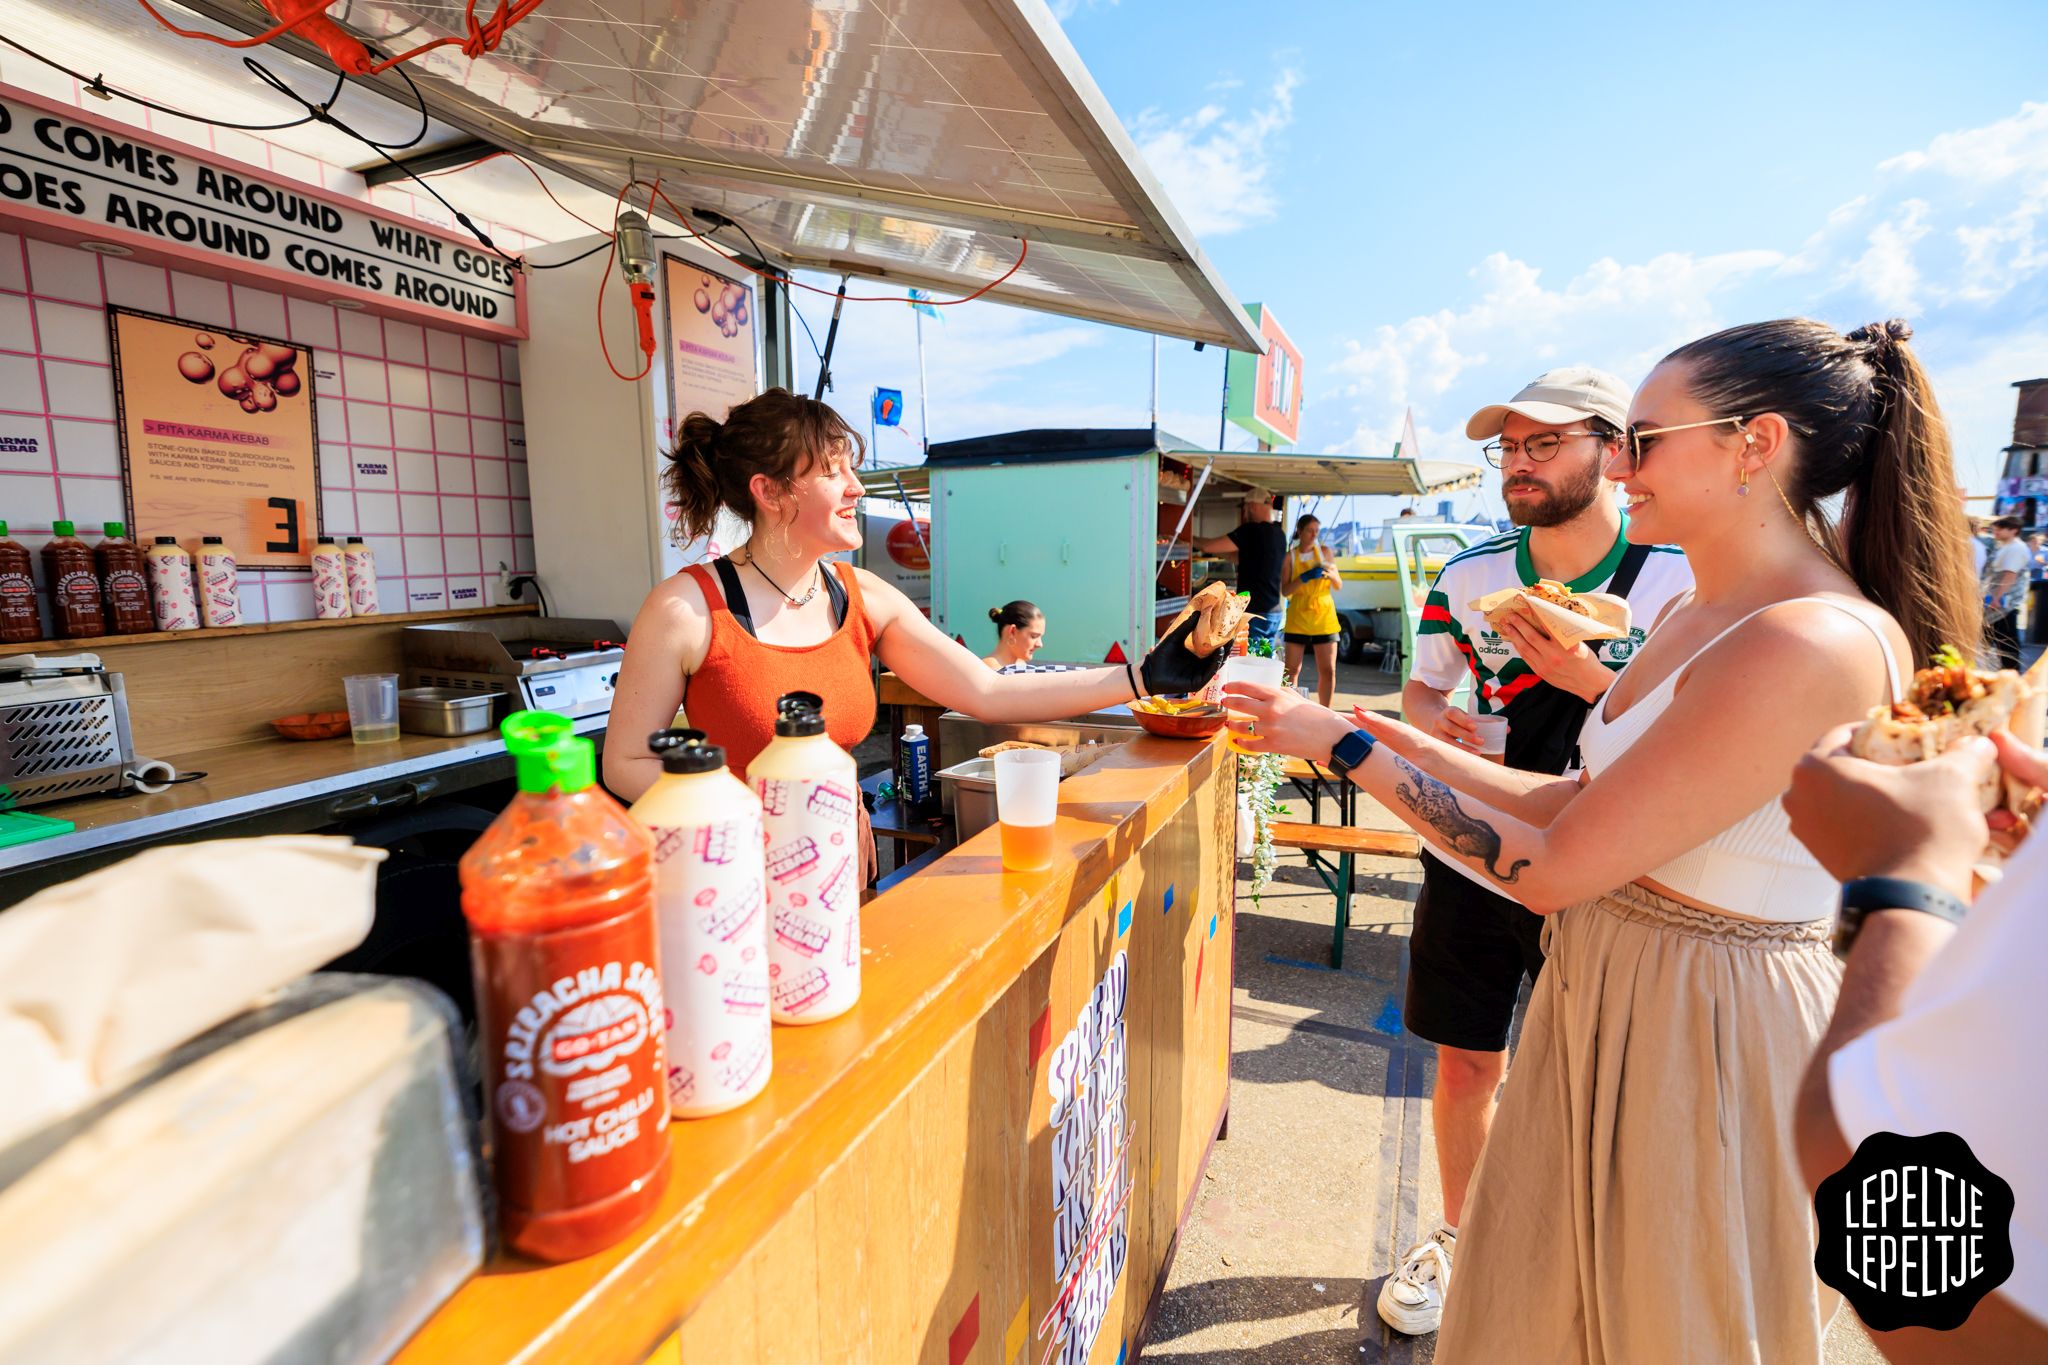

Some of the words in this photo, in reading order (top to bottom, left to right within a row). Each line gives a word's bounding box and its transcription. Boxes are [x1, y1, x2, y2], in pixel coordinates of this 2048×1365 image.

[34, 118, 179, 186] COMES
[196, 166, 343, 233] AROUND
[369, 220, 442, 265] WHAT
[453, 249, 514, 287] GOES
[106, 193, 271, 260] AROUND
[284, 244, 383, 291] COMES
[395, 272, 498, 319] AROUND
[0, 436, 39, 446] RMA
[157, 424, 185, 435] PITA
[187, 428, 230, 442] KARMA
[231, 432, 270, 446] KEBAB
[1479, 646, 1509, 655] adidas
[916, 745, 929, 791] EARTH
[1049, 950, 1128, 1128] SPREAD
[544, 1117, 592, 1144] HOT
[1052, 1020, 1128, 1212] KARMA
[568, 1118, 640, 1164] SAUCE
[1054, 1148, 1096, 1284] LIKE
